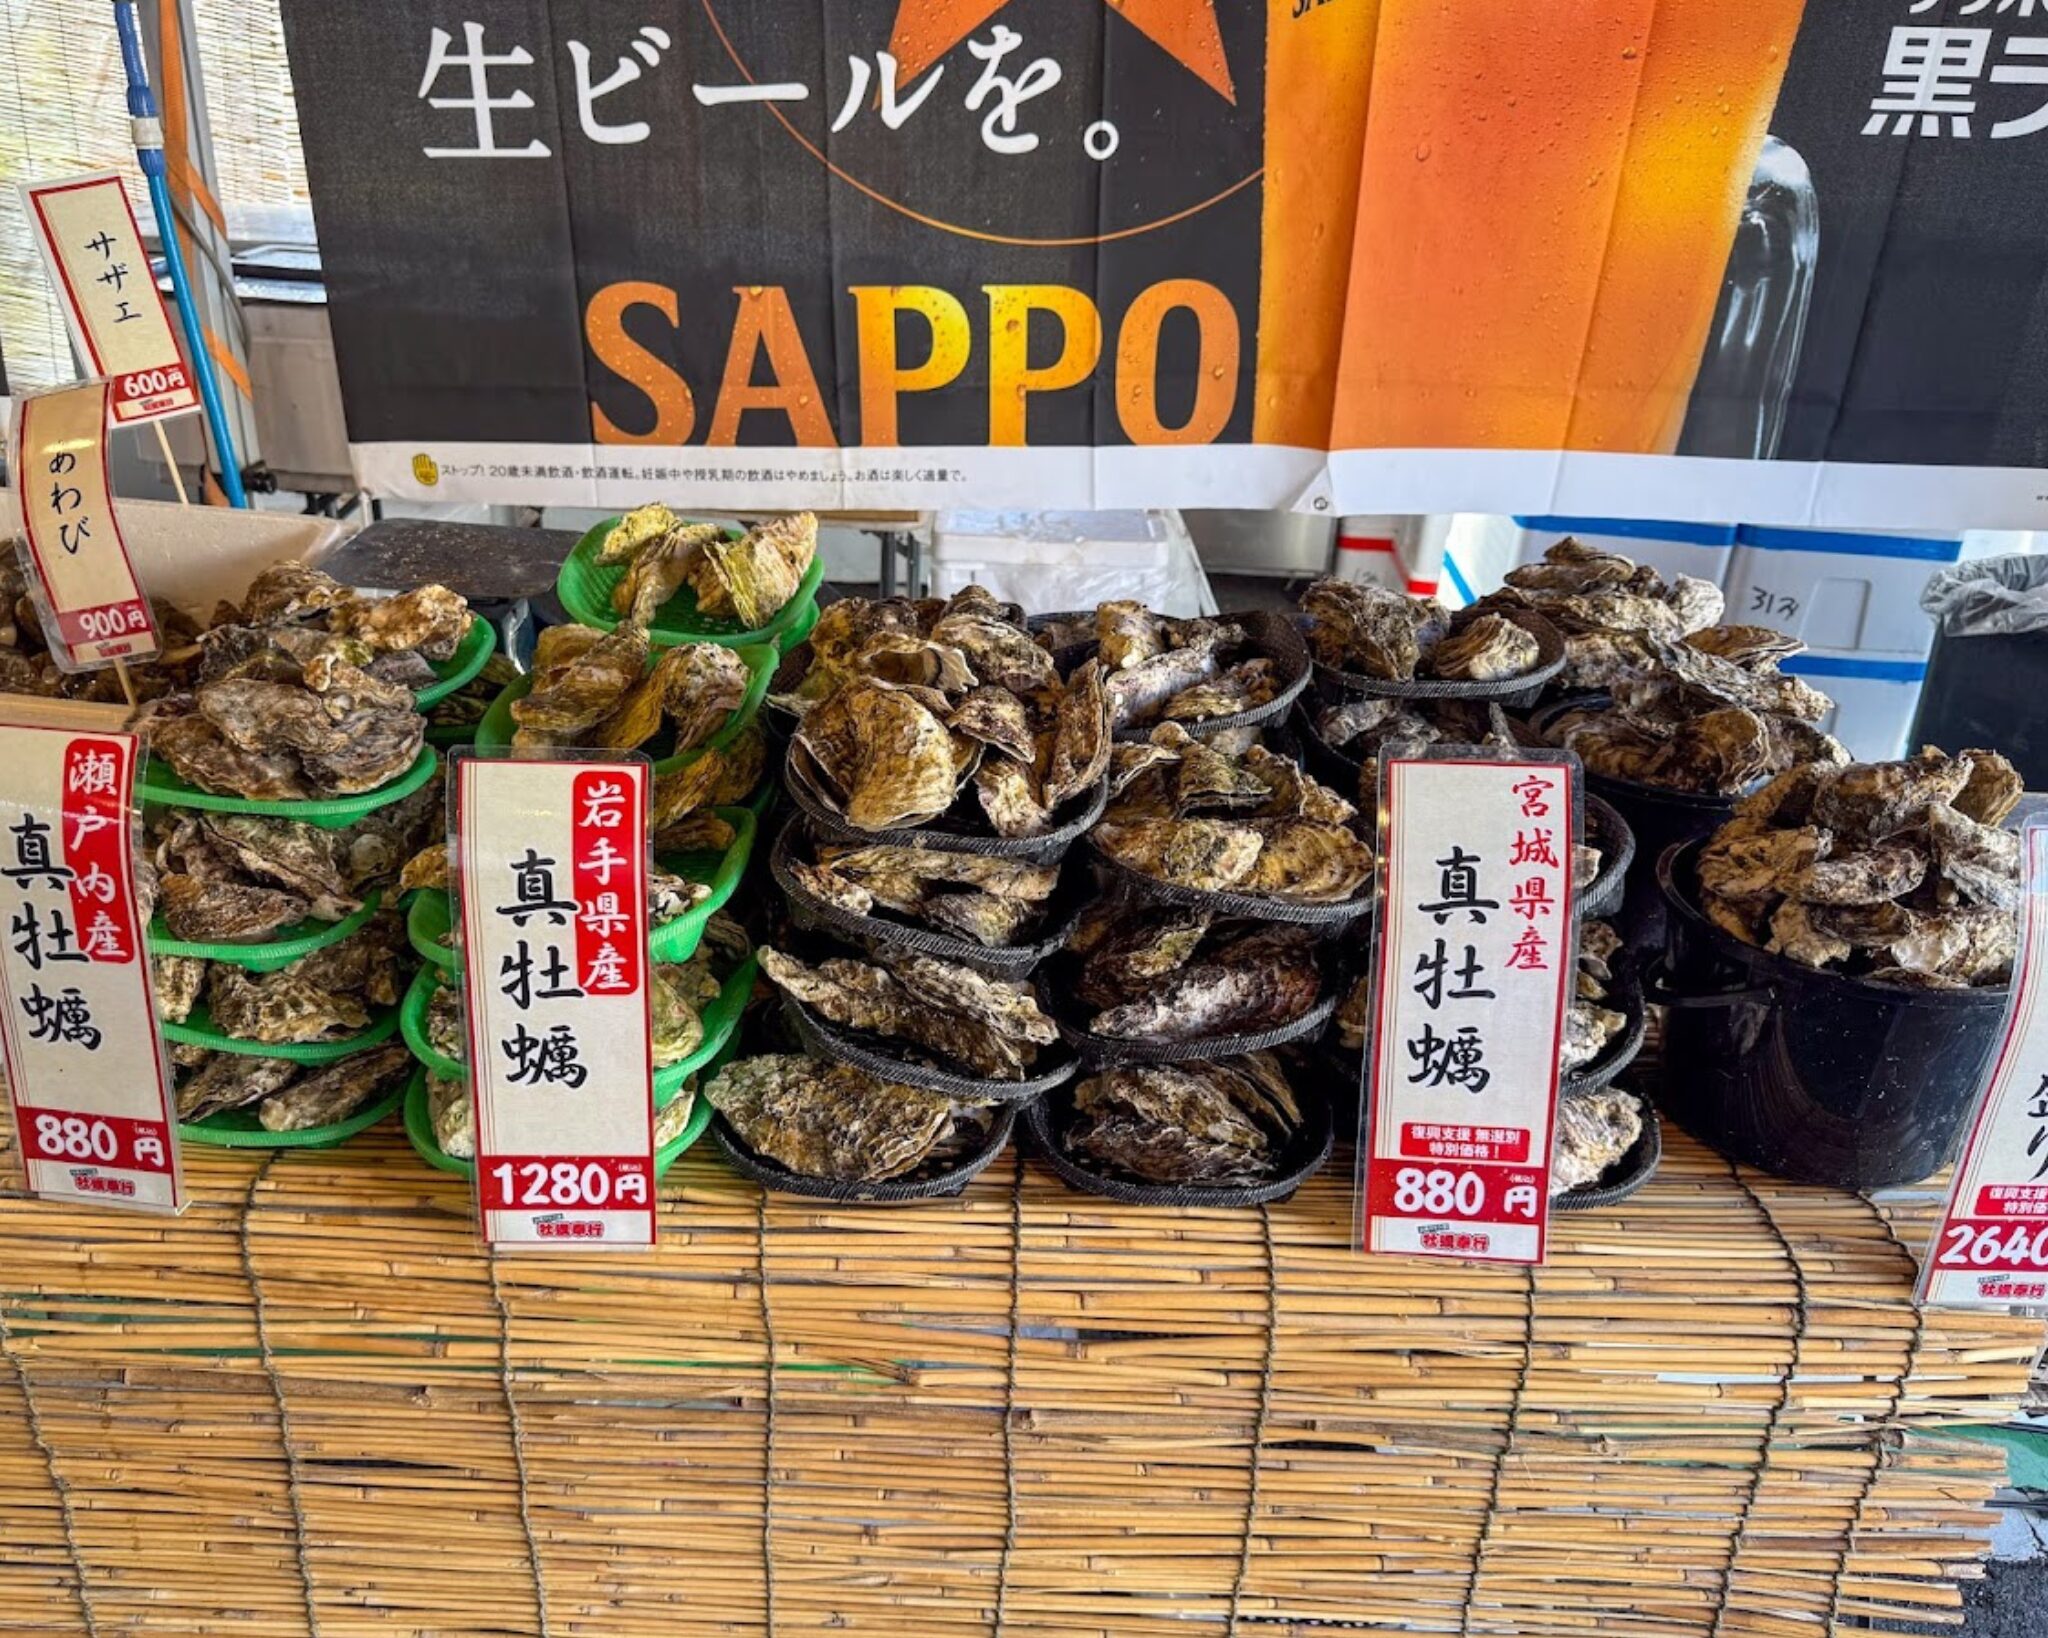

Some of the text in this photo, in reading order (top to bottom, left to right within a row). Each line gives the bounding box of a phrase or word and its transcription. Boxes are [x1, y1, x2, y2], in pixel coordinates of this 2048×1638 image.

[418, 21, 1120, 160] 生ビールを。
[84, 231, 142, 323] サザエ
[585, 279, 1241, 447] SAPPO
[124, 368, 186, 398] 600円
[79, 606, 147, 640] 900円
[0, 813, 102, 1050] 真牡蠣
[68, 748, 128, 957] 瀬戸内産
[578, 780, 631, 989] 岩手県産
[1504, 775, 1560, 970] 宮城県産
[496, 849, 589, 1089] 真牡蠣
[1407, 846, 1500, 1093] 真牡蠣
